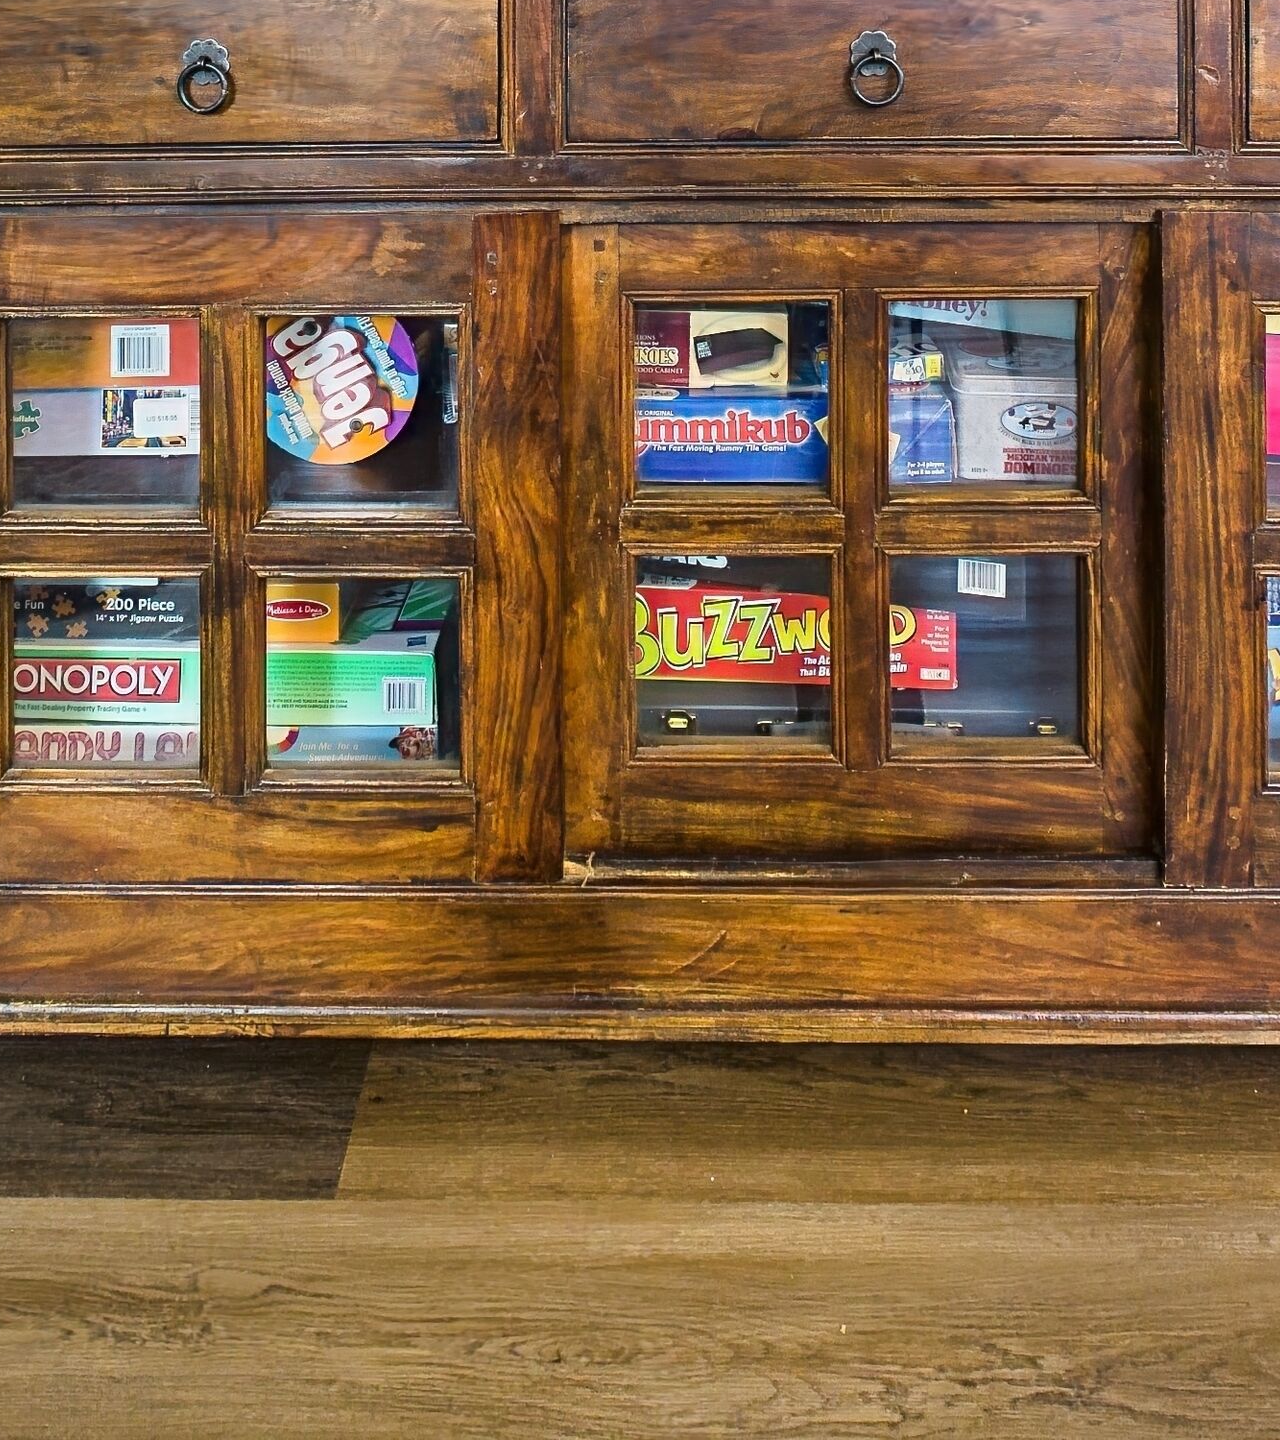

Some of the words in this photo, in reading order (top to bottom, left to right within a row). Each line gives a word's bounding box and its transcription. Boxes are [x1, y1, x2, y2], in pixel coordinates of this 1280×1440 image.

[272, 317, 389, 449] Jenga
[634, 410, 810, 452] ummikub
[669, 444, 685, 452] Fast
[686, 444, 714, 453] Moving
[715, 444, 744, 454] Rummy
[745, 444, 760, 452] Tile
[24, 600, 44, 609] Fun
[106, 598, 133, 610] 200
[138, 597, 175, 610] Piece
[129, 615, 157, 624] Jigsaw
[889, 662, 908, 673] ain
[13, 663, 174, 696] ONOPOLY
[67, 704, 96, 713] Property
[14, 730, 122, 761] ANDY
